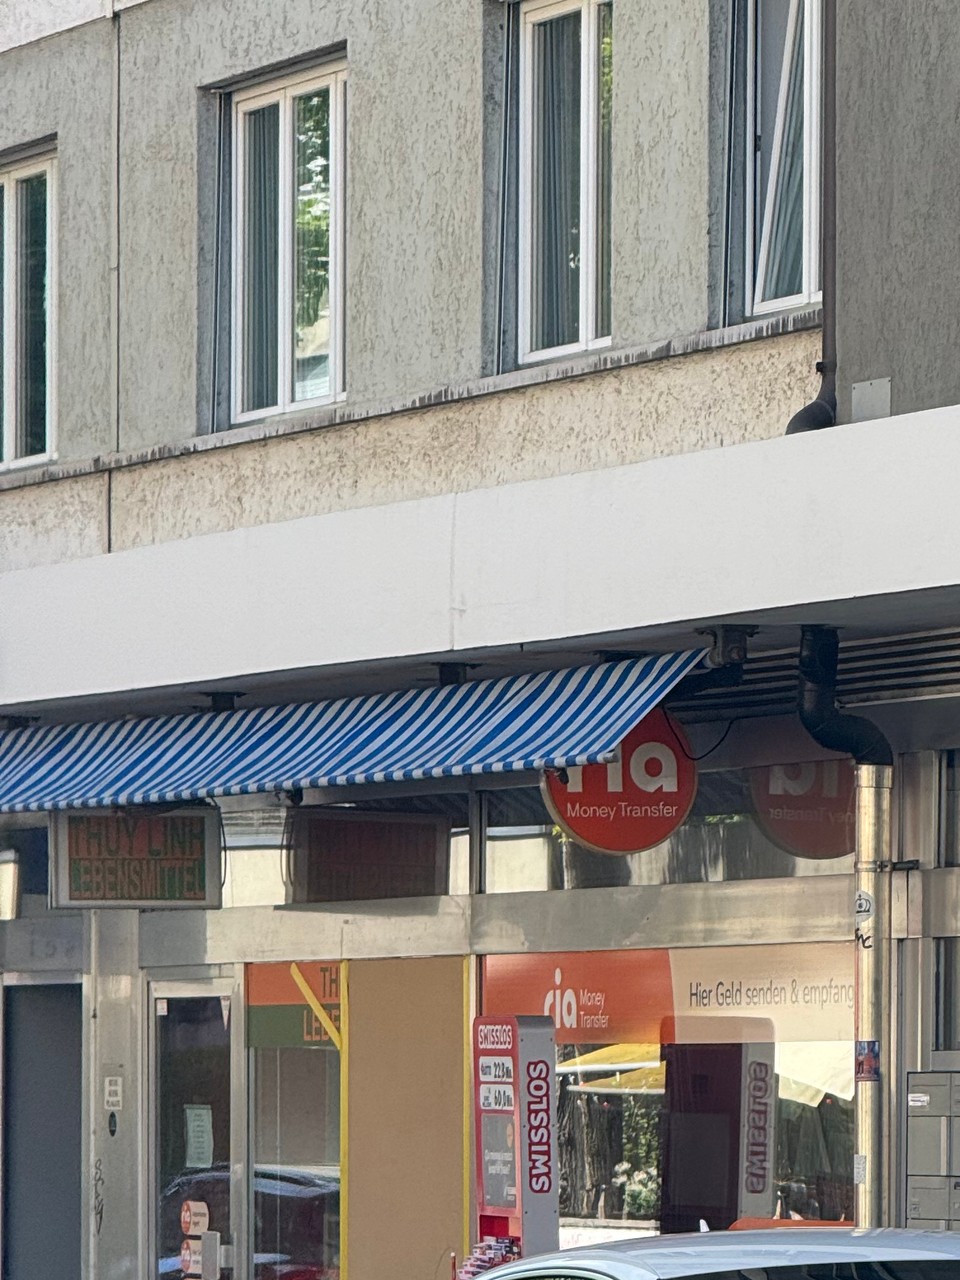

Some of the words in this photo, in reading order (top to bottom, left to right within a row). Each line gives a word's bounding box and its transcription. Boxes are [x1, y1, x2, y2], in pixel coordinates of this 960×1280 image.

[566, 802, 616, 821] Money
[618, 801, 678, 818] Transfer
[544, 967, 577, 1029] ria
[580, 989, 605, 1010] Money
[689, 981, 713, 1008] Hier
[716, 981, 742, 1007] Geld
[746, 979, 786, 1006] senden
[791, 978, 800, 1005] &
[580, 1009, 609, 1028] Transfer
[478, 1025, 513, 1050] SWISSLOS
[527, 1060, 551, 1194] SWISSLOS
